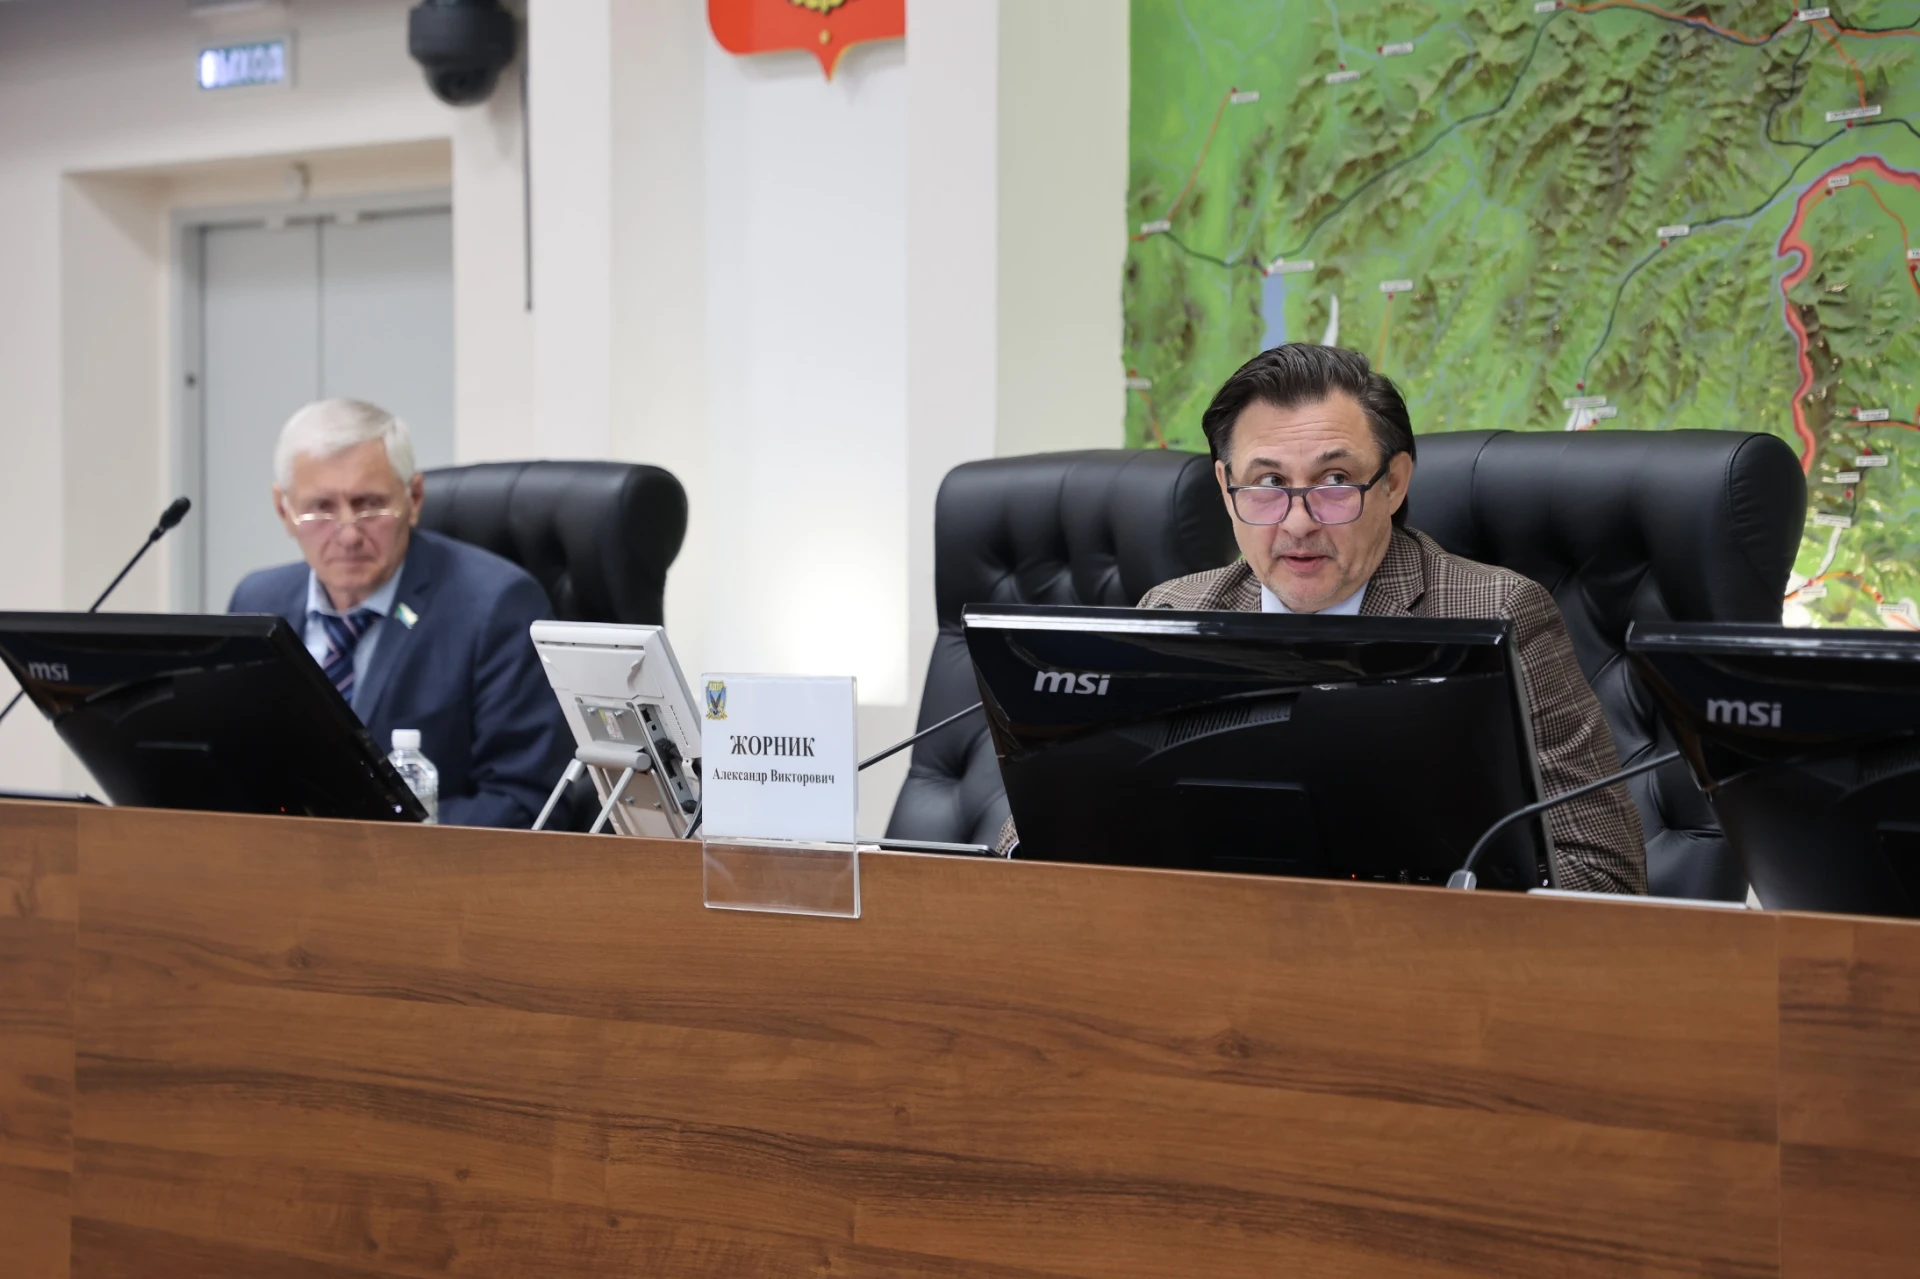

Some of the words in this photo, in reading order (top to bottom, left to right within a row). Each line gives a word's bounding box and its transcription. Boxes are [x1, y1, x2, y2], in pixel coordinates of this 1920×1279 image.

[28, 661, 69, 681] msi
[1034, 671, 1111, 695] msi
[1707, 699, 1782, 728] msi
[730, 735, 815, 757] ЖОРНИК
[712, 767, 768, 785] Александр
[770, 769, 835, 787] Викторович
